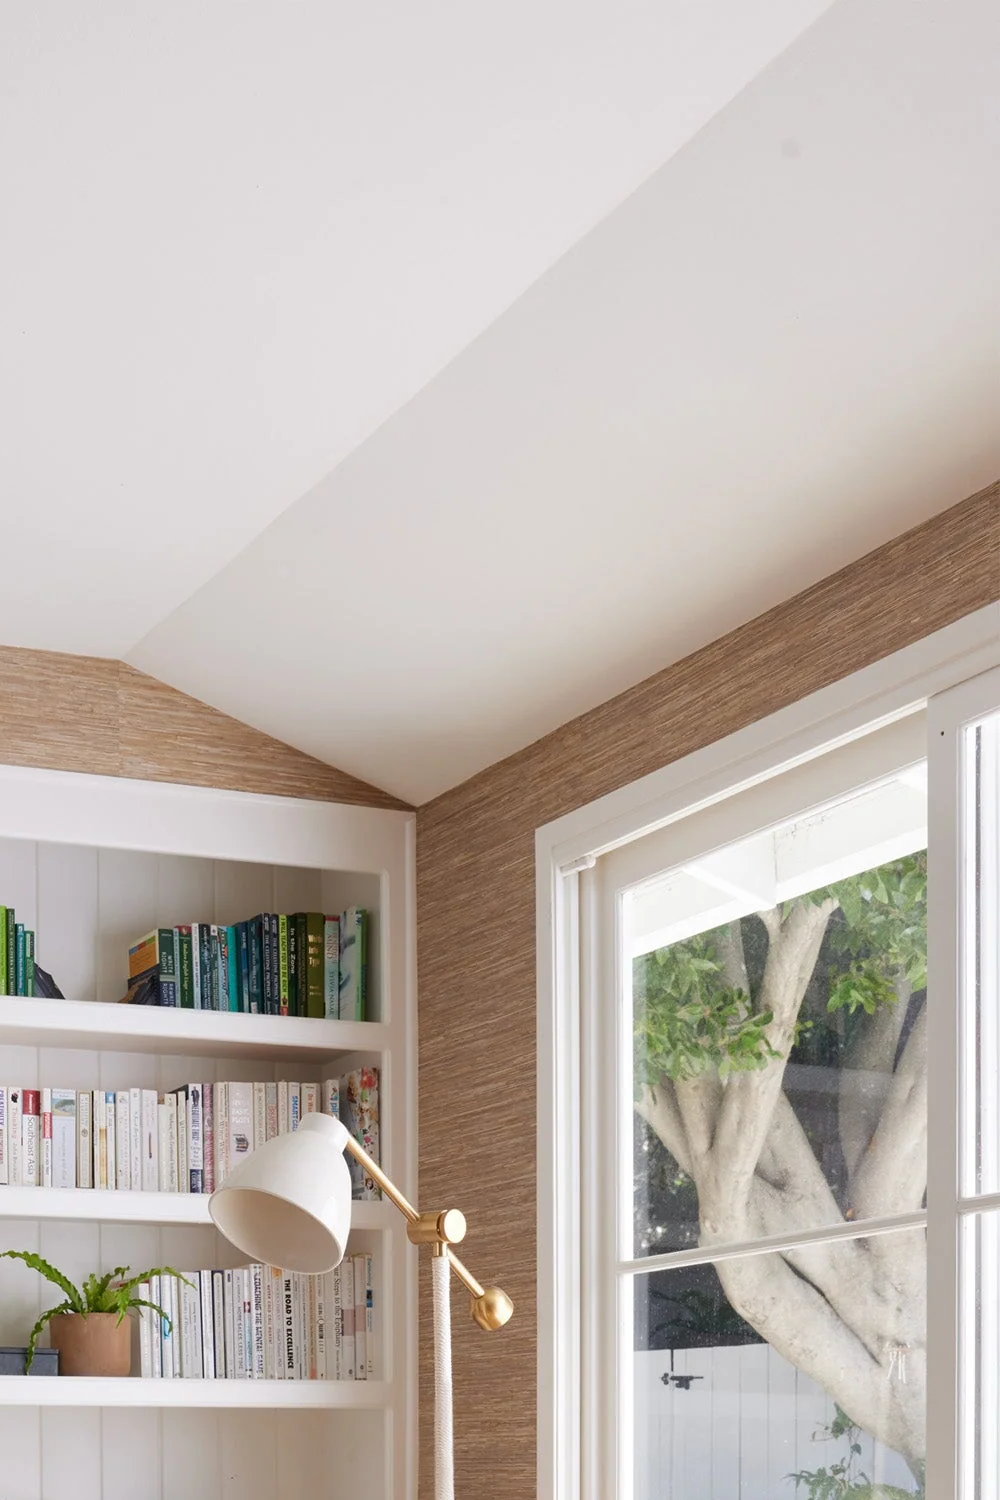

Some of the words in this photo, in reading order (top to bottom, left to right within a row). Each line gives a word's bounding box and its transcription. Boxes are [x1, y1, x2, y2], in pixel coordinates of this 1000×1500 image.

[27, 1116, 35, 1156] Southeast
[27, 1158, 35, 1175] Asia
[254, 1278, 262, 1311] COACHING
[284, 1294, 292, 1314] ROAD
[285, 1314, 292, 1326] TO
[285, 1328, 294, 1369] EXCELLENCE
[256, 1353, 264, 1374] GAME
